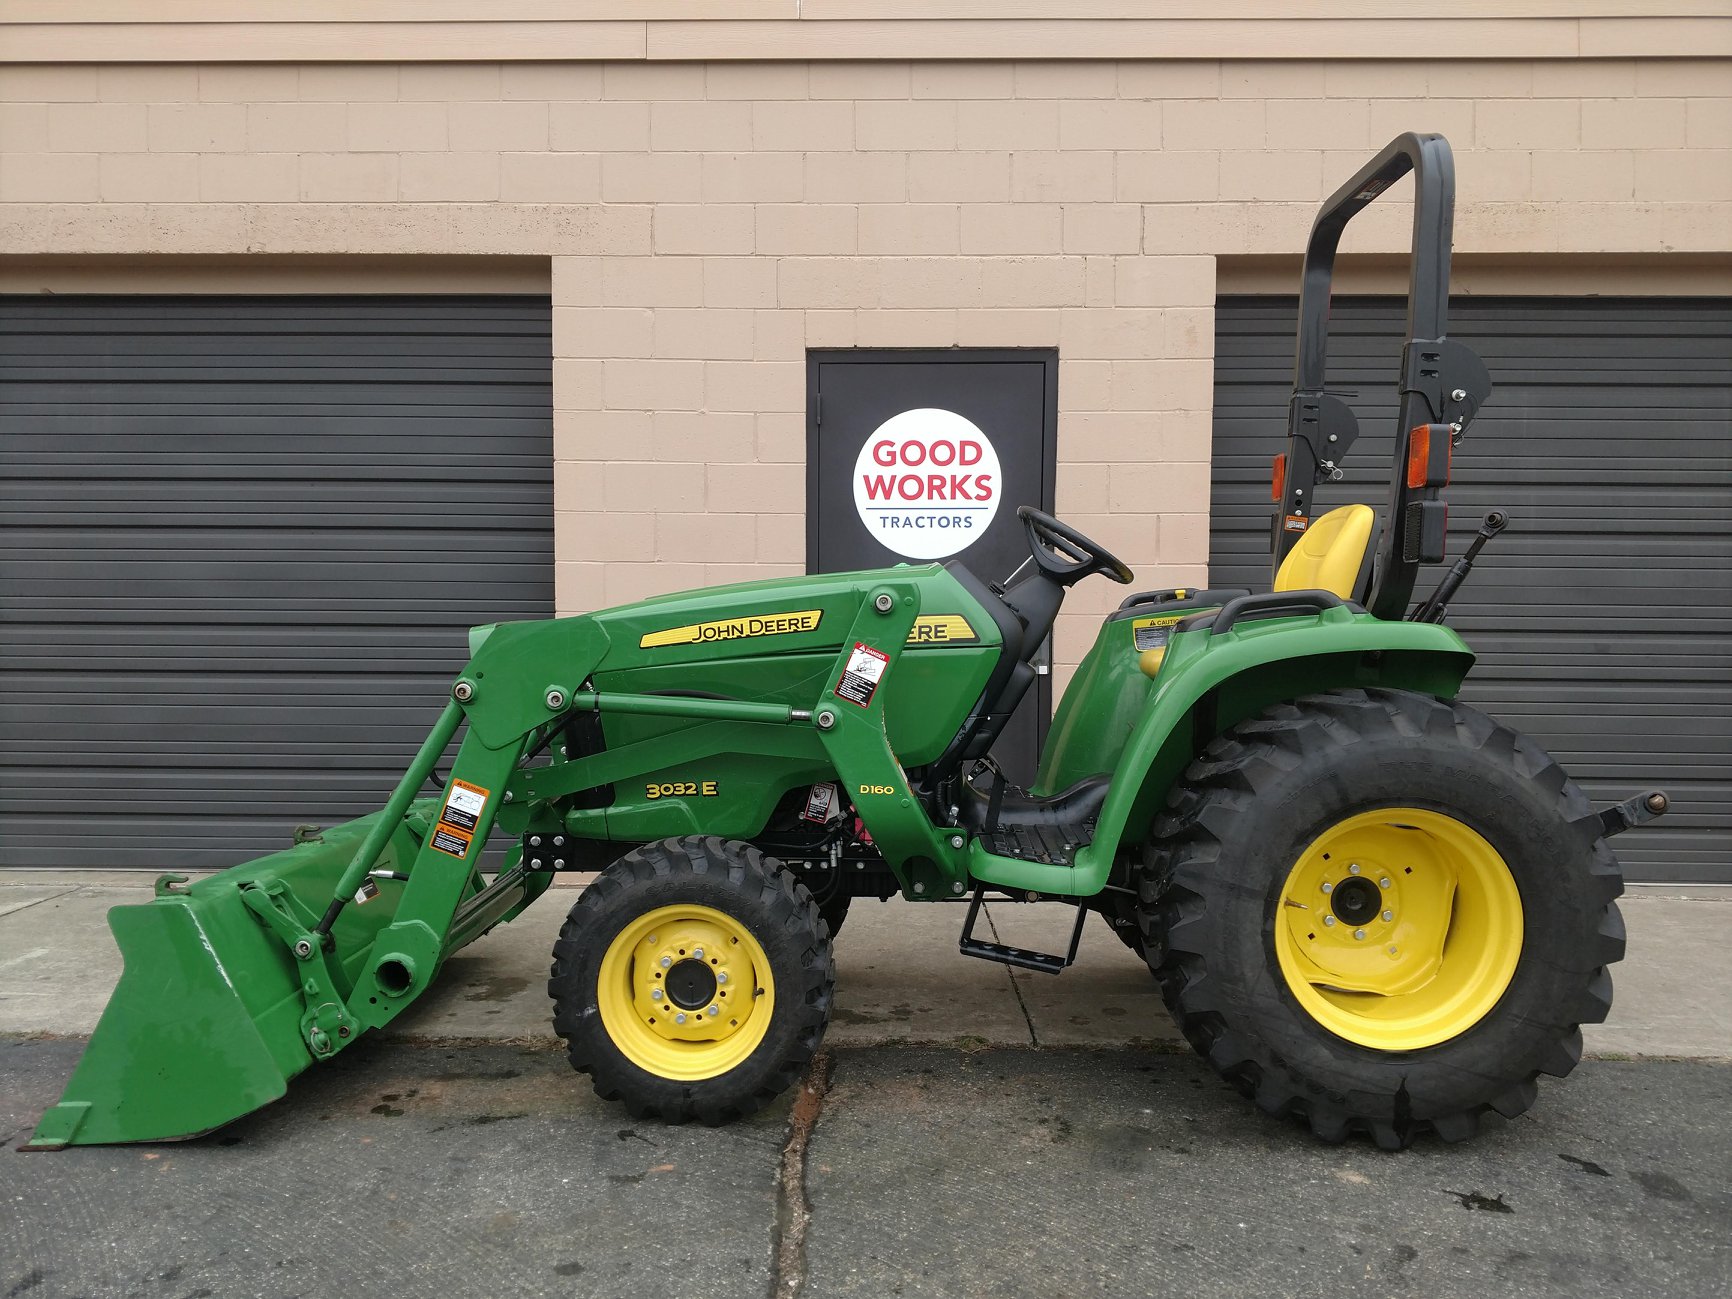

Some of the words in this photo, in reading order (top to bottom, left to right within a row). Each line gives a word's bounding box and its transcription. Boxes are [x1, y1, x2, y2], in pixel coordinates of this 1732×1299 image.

[873, 440, 983, 467] GOOD
[862, 474, 993, 501] WORKS
[879, 516, 973, 529] TRACTORS
[692, 623, 743, 641] JOHN
[748, 616, 812, 634] DEERE
[865, 648, 886, 660] DANGER
[646, 782, 698, 799] 3032
[702, 781, 717, 795] E
[860, 784, 894, 795] D160
[446, 828, 468, 840] WARNING
